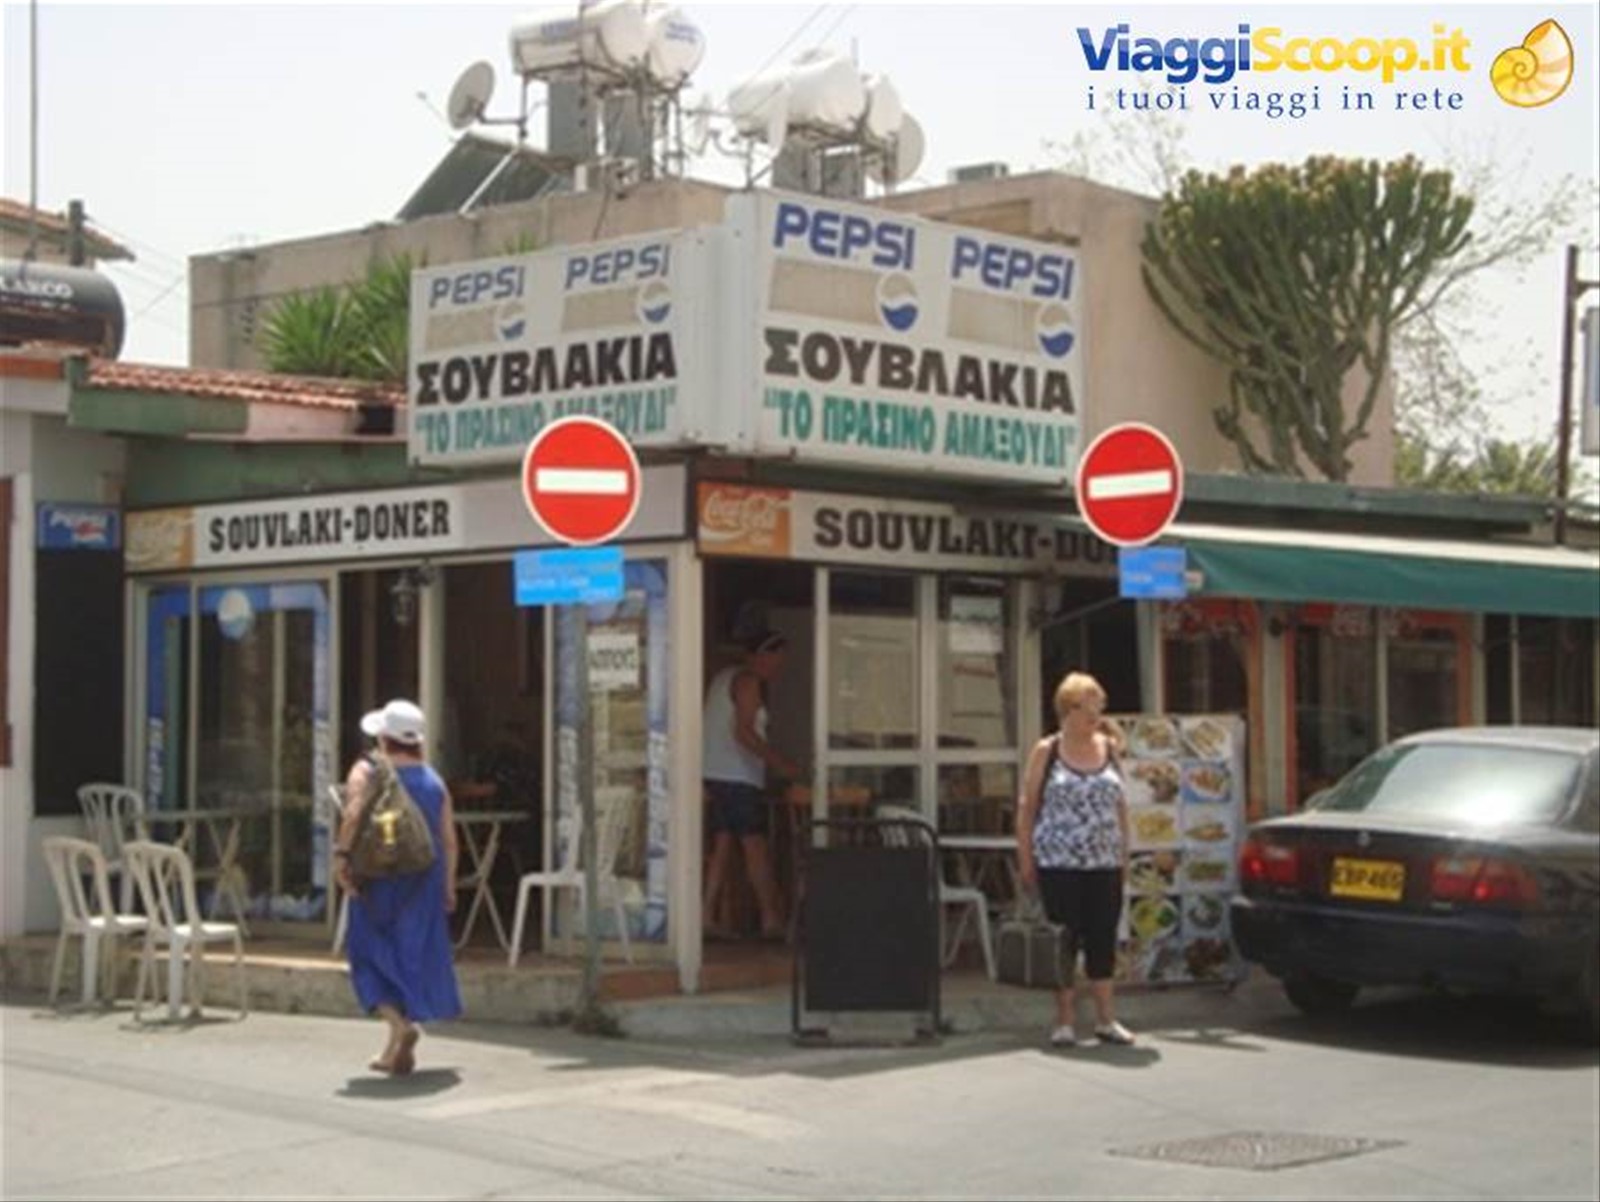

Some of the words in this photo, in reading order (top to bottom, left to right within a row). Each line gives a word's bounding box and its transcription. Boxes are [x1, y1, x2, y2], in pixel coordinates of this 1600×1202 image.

[565, 243, 671, 290] PEPSI
[774, 202, 915, 271] PEPSI
[950, 235, 1075, 300] PEPSI
[430, 265, 525, 308] PEPSI
[416, 332, 678, 406] ΣΟΥΒΛΑΚΙΑ
[764, 326, 1076, 415] ΣΟΥΒΛΑΚΙΑ
[822, 394, 936, 454] ΠΡΑΣΙΝΟ
[208, 499, 451, 553] SOUVLAKI-DONER
